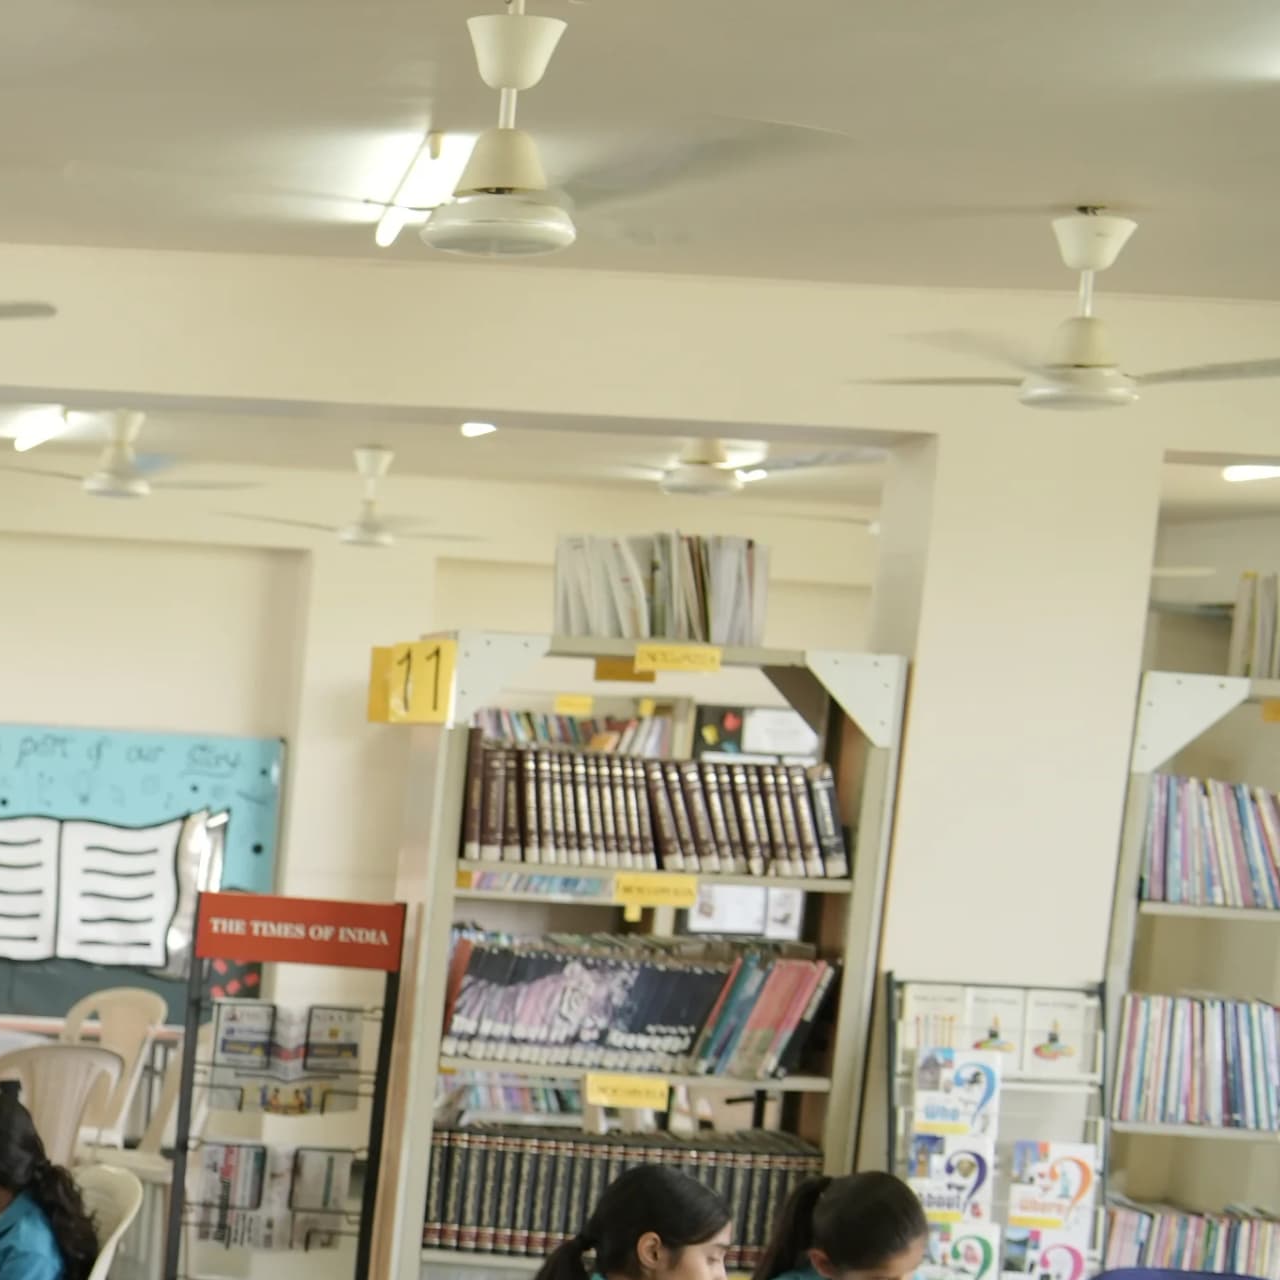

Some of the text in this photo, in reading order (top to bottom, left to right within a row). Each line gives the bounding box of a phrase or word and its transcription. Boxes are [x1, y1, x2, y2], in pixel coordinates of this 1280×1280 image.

[209, 916, 390, 946] THE TIMES OF INDIA
